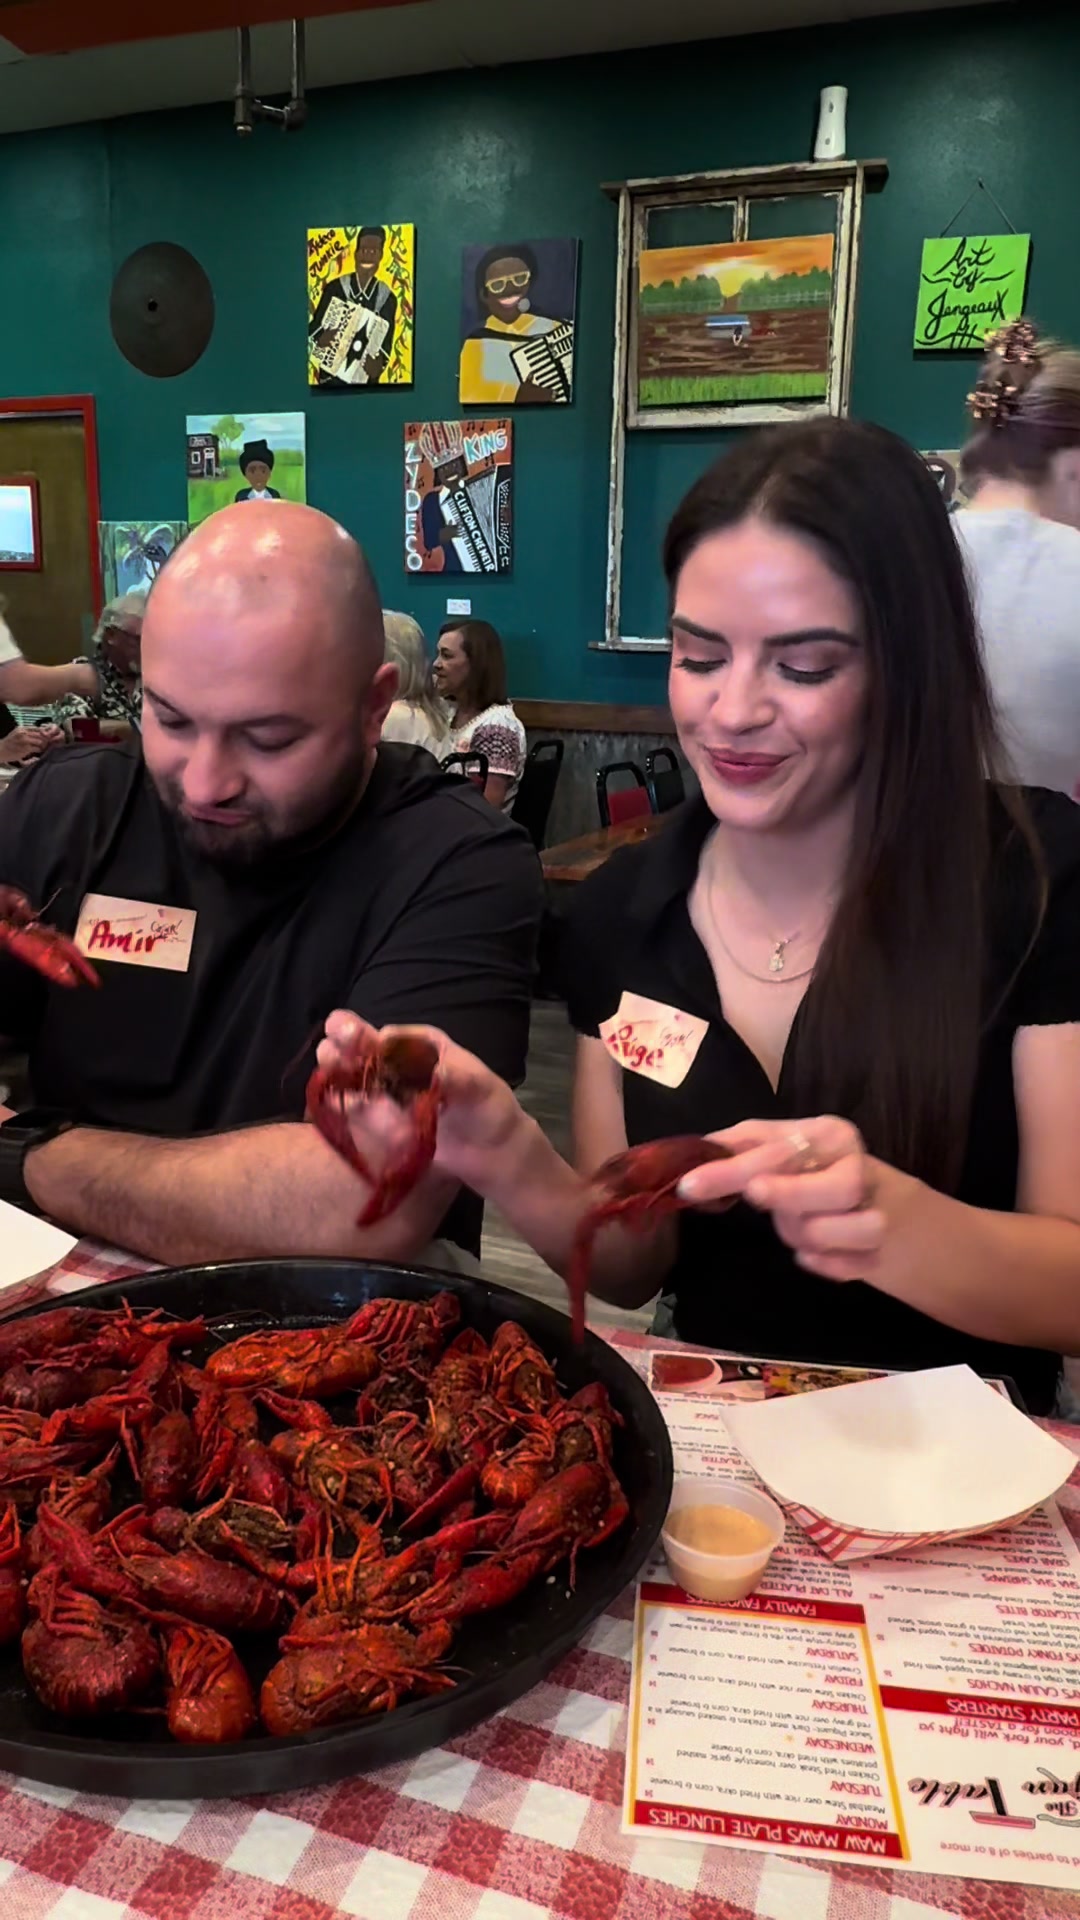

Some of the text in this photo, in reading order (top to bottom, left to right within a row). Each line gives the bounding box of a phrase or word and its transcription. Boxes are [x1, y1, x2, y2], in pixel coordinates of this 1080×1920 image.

[934, 237, 996, 276] Art
[463, 428, 508, 465] KING
[404, 442, 423, 571] ZYDECO
[453, 491, 477, 531] CLIFTON
[88, 920, 158, 953] Amir
[760, 1581, 853, 1598] ALL DAT PLATTER
[764, 1599, 816, 1616] FAMILY
[996, 1605, 1028, 1616] BITES
[805, 1647, 859, 1661] SATURDAY
[968, 1643, 1024, 1656] POTATOES
[657, 1671, 687, 1680] brownie
[824, 1674, 863, 1687] FRIDAY
[717, 1676, 736, 1686] okra,
[738, 1680, 757, 1689] fried
[967, 1678, 1015, 1692] NACHOS
[779, 1685, 793, 1693] rice
[815, 1689, 834, 1699] Stew
[1018, 1684, 1058, 1698] CAJUN
[836, 1692, 866, 1702] Chicken
[670, 1699, 700, 1709] brownie
[811, 1700, 868, 1715] THURSDAY
[665, 1707, 695, 1717] sausage
[732, 1706, 751, 1715] okra,
[753, 1709, 772, 1718] fried
[946, 1698, 1080, 1726] PARTY STARTERS
[697, 1712, 727, 1722] smoked
[738, 1717, 767, 1726] chicken
[832, 1717, 854, 1727] gravy
[770, 1721, 788, 1729] meat
[792, 1724, 810, 1733] Dark
[919, 1722, 934, 1731] ya
[939, 1723, 969, 1737] fight
[849, 1730, 873, 1741] Sauce
[974, 1730, 998, 1739] will
[1003, 1733, 1029, 1744] fork
[805, 1737, 875, 1754] WEDNESDAY
[1034, 1736, 1064, 1746] your
[676, 1749, 707, 1759] mashed
[711, 1744, 743, 1754] brownie
[753, 1748, 773, 1757] corn
[711, 1753, 731, 1763] garlic
[775, 1750, 795, 1760] okra,
[798, 1754, 818, 1763] fried
[734, 1756, 776, 1768] homestyle
[820, 1756, 838, 1765] with
[841, 1759, 878, 1769] potatoes
[799, 1764, 822, 1775] Steak
[824, 1768, 845, 1779] Fried
[848, 1770, 880, 1781] Chicken
[650, 1777, 682, 1789] brownie
[694, 1784, 713, 1792] corn
[716, 1786, 737, 1796] okra,
[830, 1780, 882, 1797] TUESDAY
[739, 1789, 760, 1799] fried
[763, 1792, 781, 1801] with
[784, 1794, 800, 1803] rice
[825, 1800, 846, 1810] Stew
[848, 1803, 885, 1814] Meatball
[908, 1777, 1036, 1830] Table
[1044, 1801, 1078, 1816] The
[836, 1814, 888, 1830] MONDAY
[649, 1808, 886, 1854] MAW MAWS PLATE LUNCHES
[940, 1842, 971, 1852] more
[974, 1846, 986, 1854] or
[988, 1847, 996, 1856] 8
[998, 1848, 1010, 1858] of
[1012, 1850, 1054, 1862] parties
[1056, 1855, 1069, 1864] to
